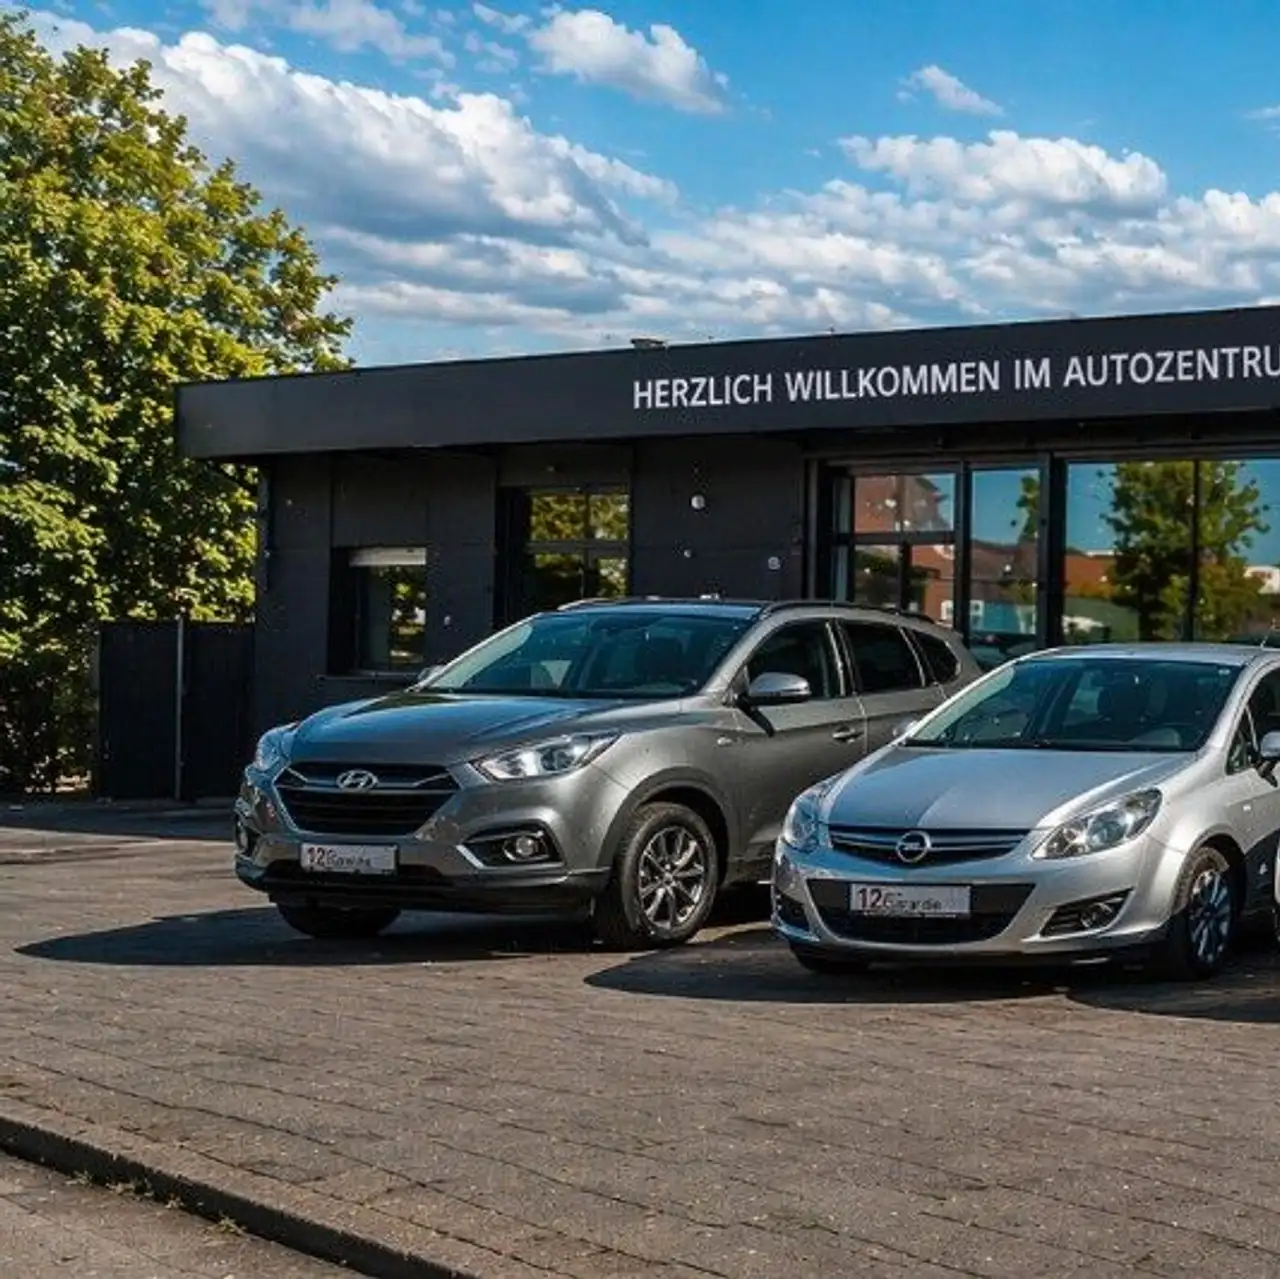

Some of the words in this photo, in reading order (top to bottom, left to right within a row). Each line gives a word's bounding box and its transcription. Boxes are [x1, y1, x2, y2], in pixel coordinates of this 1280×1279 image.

[633, 373, 772, 409] HERZLICH
[785, 360, 1001, 402] WILLKOMMEN
[1014, 357, 1051, 390] IM
[858, 887, 882, 909] 12
